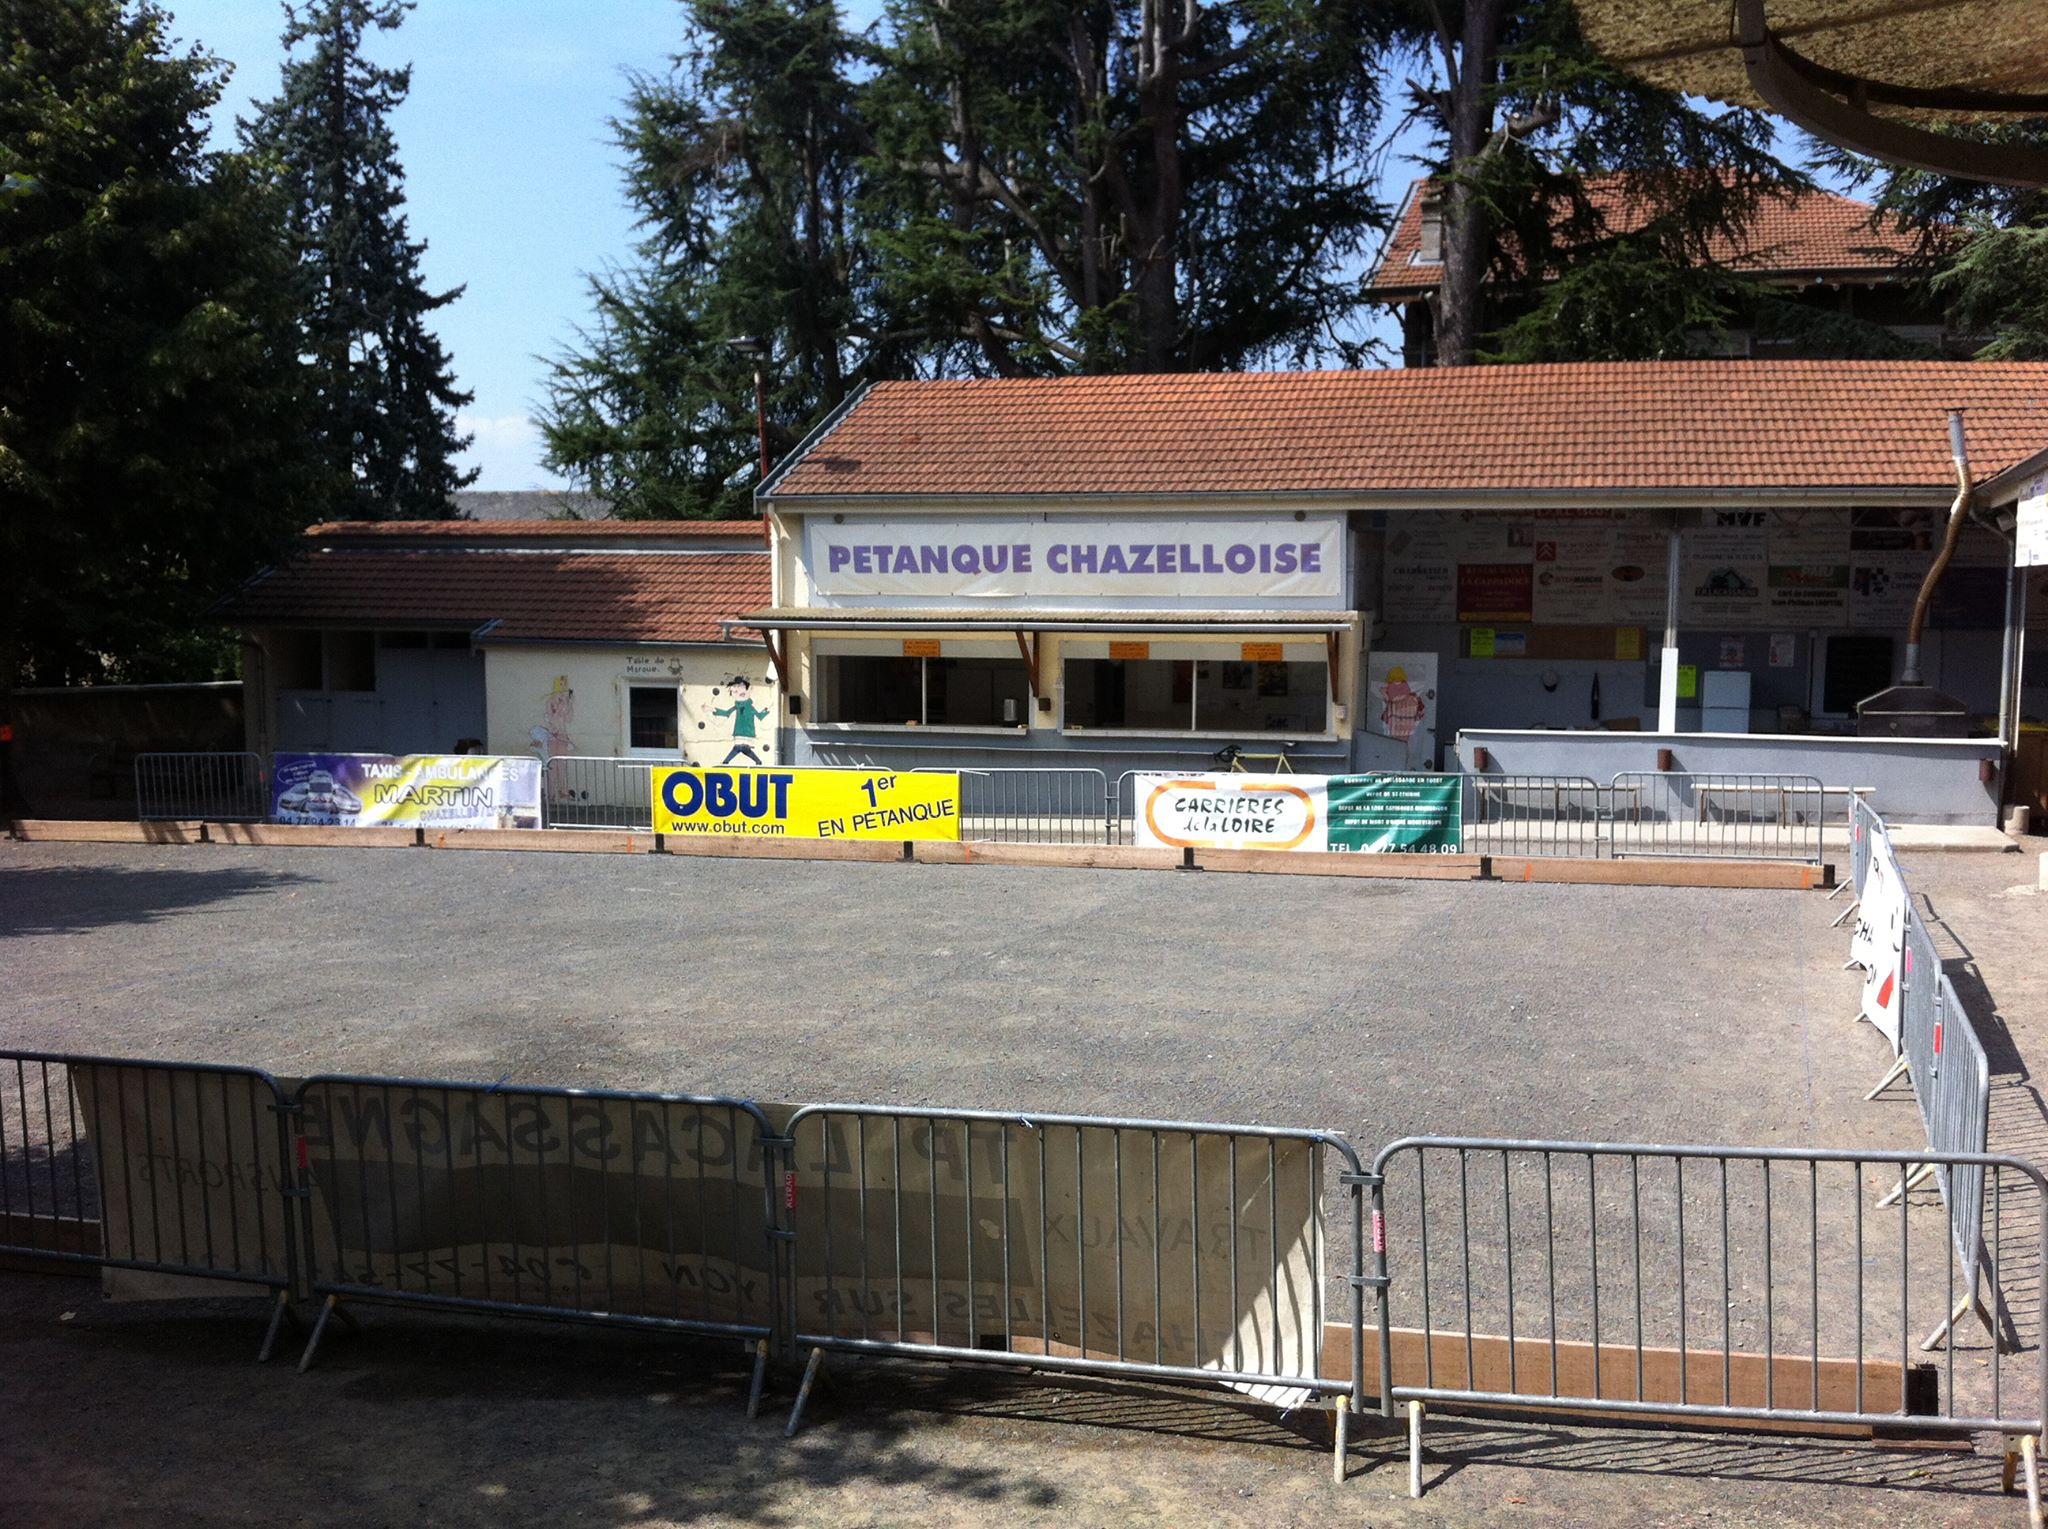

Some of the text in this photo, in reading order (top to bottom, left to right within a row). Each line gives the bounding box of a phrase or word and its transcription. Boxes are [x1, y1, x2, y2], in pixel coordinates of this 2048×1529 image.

[1716, 512, 1765, 527] MVF
[828, 543, 1322, 576] PETANQUE CHAZELLOISE
[361, 763, 403, 778] TAXIS
[414, 764, 521, 782] AMBULANES
[373, 784, 494, 808] MARTIN
[661, 770, 794, 819] OBUT
[861, 774, 898, 807] 1er
[672, 820, 785, 835] www.obut.com
[818, 799, 955, 838] EN PÉTANQUE
[1221, 818, 1276, 833] LOIRE
[1440, 843, 1458, 854] 09
[785, 1173, 794, 1209] ALTRAD
